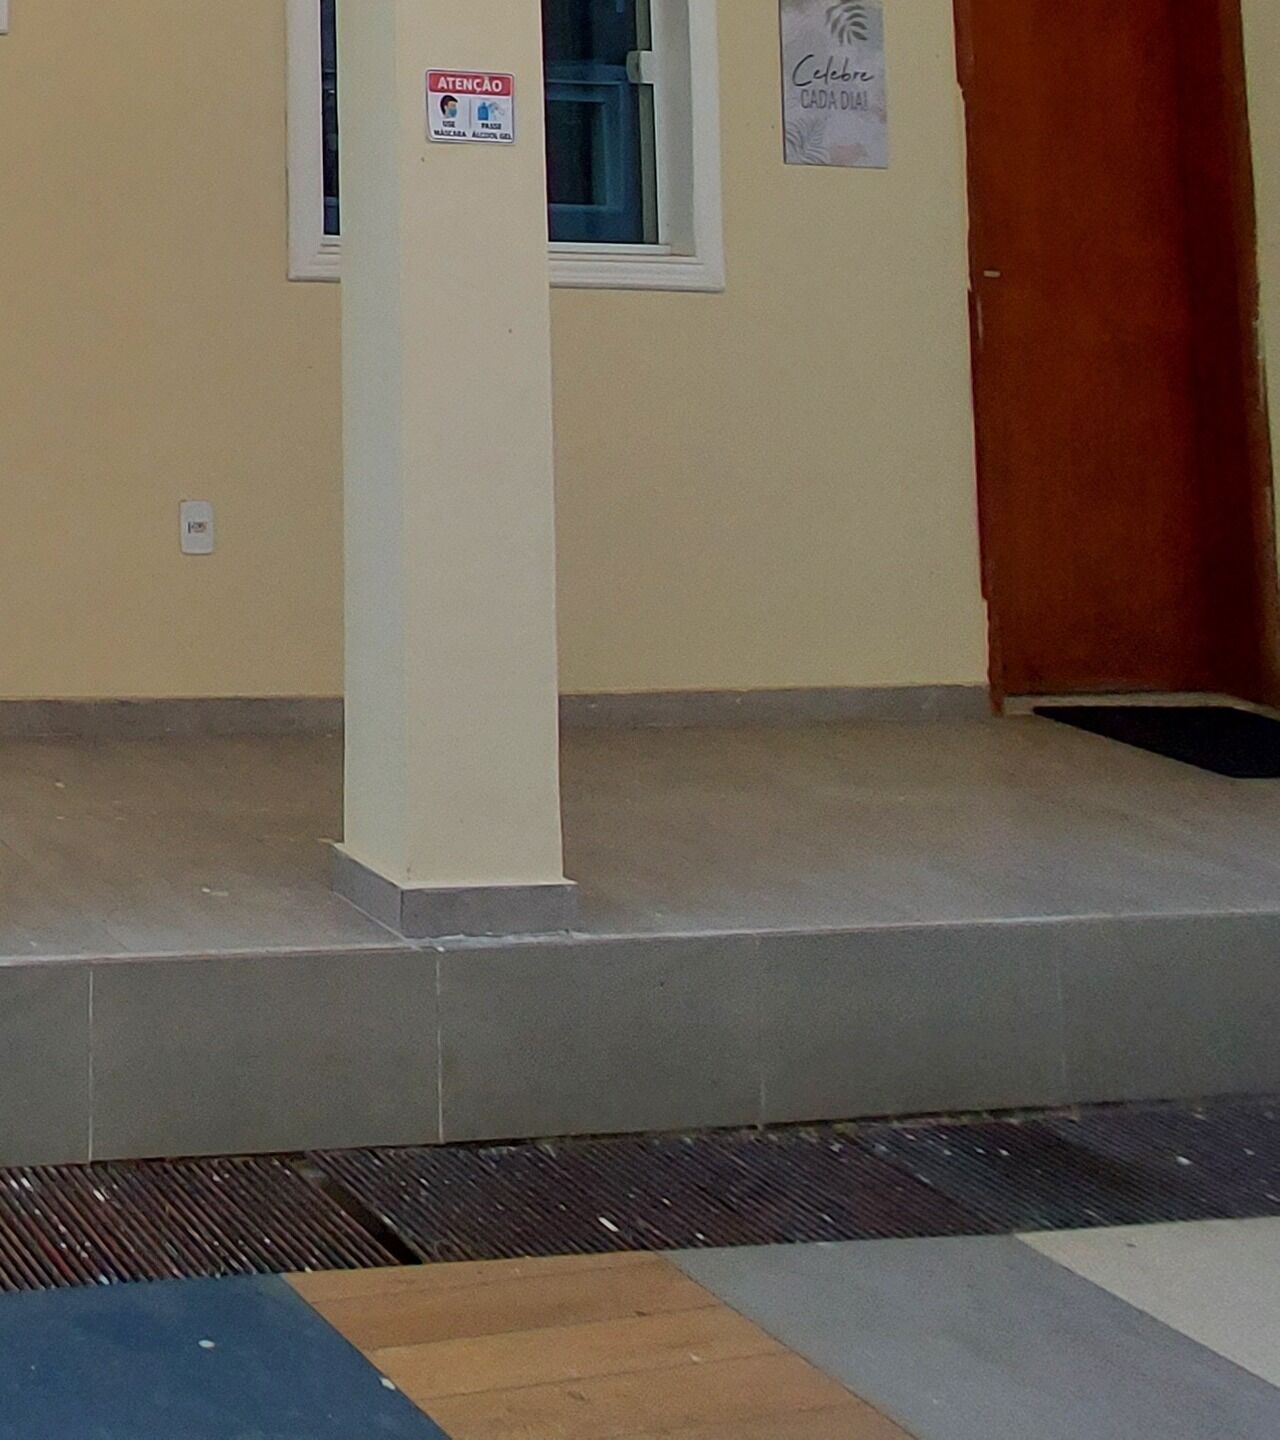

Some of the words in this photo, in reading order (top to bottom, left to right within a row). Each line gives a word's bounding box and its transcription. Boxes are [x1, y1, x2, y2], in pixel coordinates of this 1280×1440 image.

[792, 53, 874, 87] Celebre
[437, 75, 503, 94] ATENÇÃO
[801, 89, 837, 109] CADA
